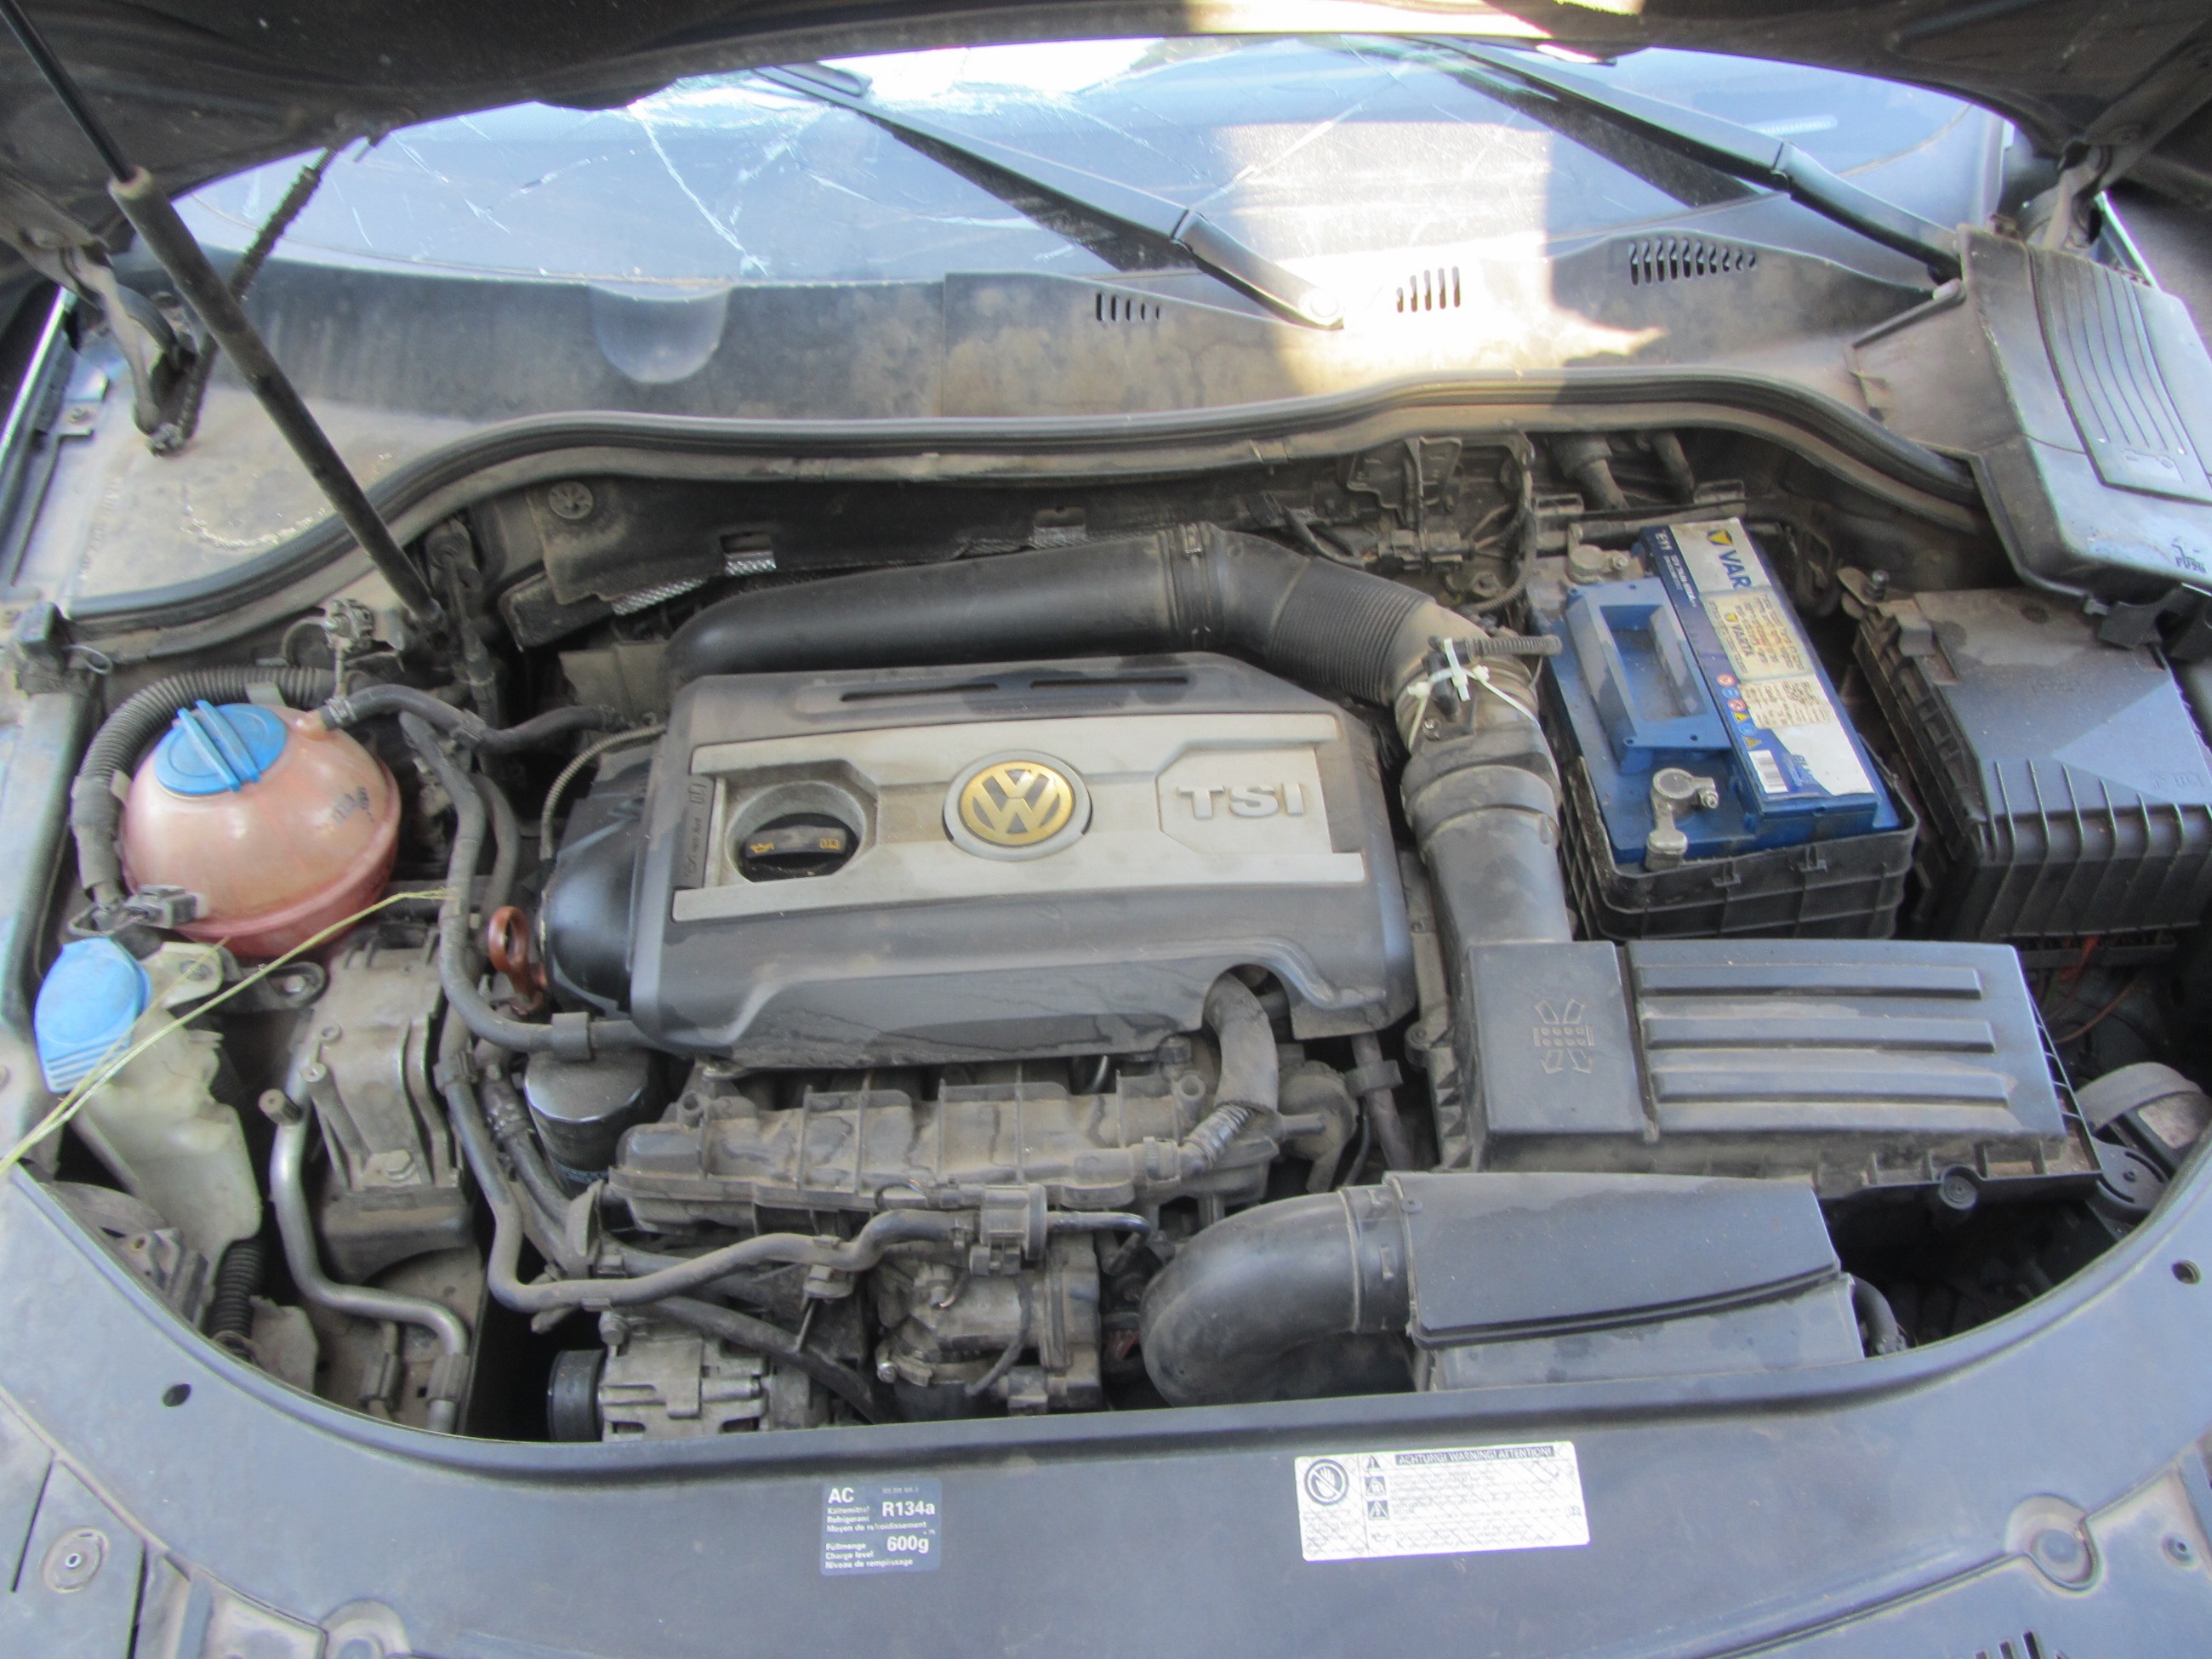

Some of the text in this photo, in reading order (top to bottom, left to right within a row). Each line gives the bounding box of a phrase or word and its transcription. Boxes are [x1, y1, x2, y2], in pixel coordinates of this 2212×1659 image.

[1719, 550, 1752, 590] VAR
[1731, 624, 1755, 658] VARTA
[1177, 782, 1304, 821] TSI
[1400, 1445, 1553, 1465] ACHTUNG! WARNING! ATTENTION!
[828, 1487, 855, 1504] AC
[882, 1500, 936, 1517] R134a
[826, 1524, 853, 1533] Moyen
[855, 1523, 865, 1531] de
[887, 1535, 929, 1554] 600g
[824, 1560, 853, 1570] Niveau
[854, 1559, 864, 1568] de
[825, 1550, 875, 1561] Charge level
